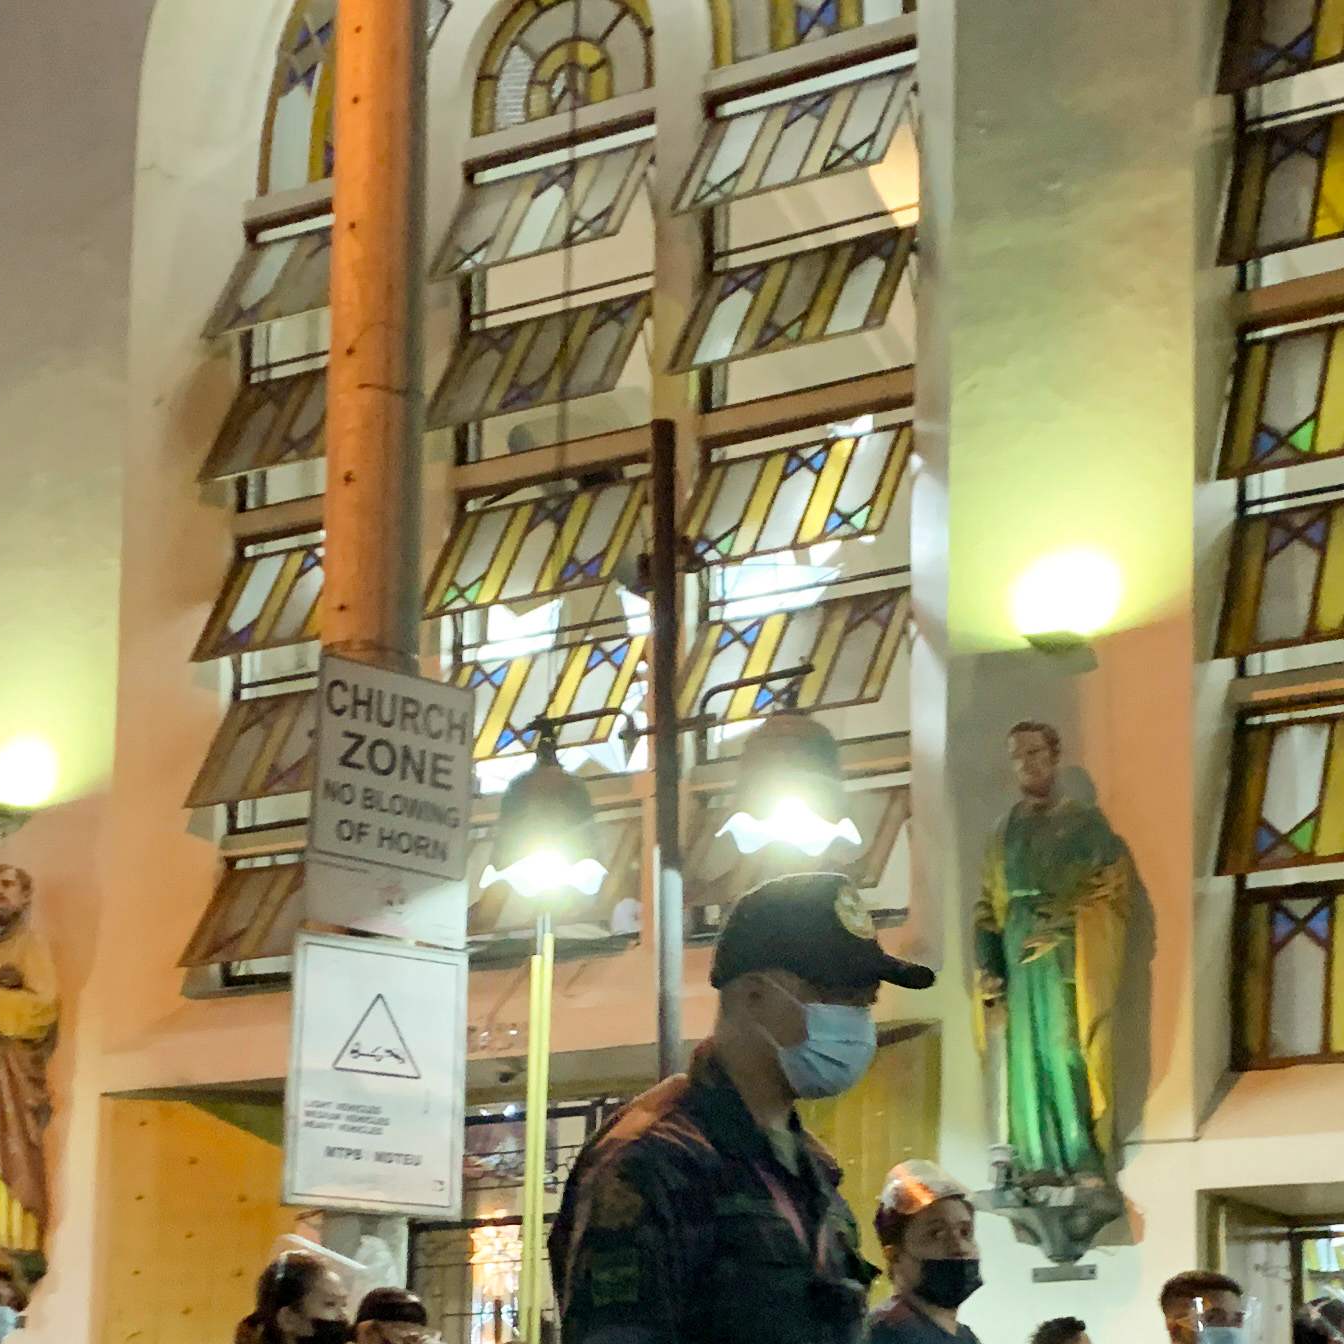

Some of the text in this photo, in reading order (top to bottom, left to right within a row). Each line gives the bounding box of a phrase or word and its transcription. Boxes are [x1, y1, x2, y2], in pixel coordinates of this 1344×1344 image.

[326, 679, 468, 745] CHURCH
[338, 730, 455, 791] ZONE
[323, 779, 354, 806] NO
[336, 819, 449, 863] OF HORN
